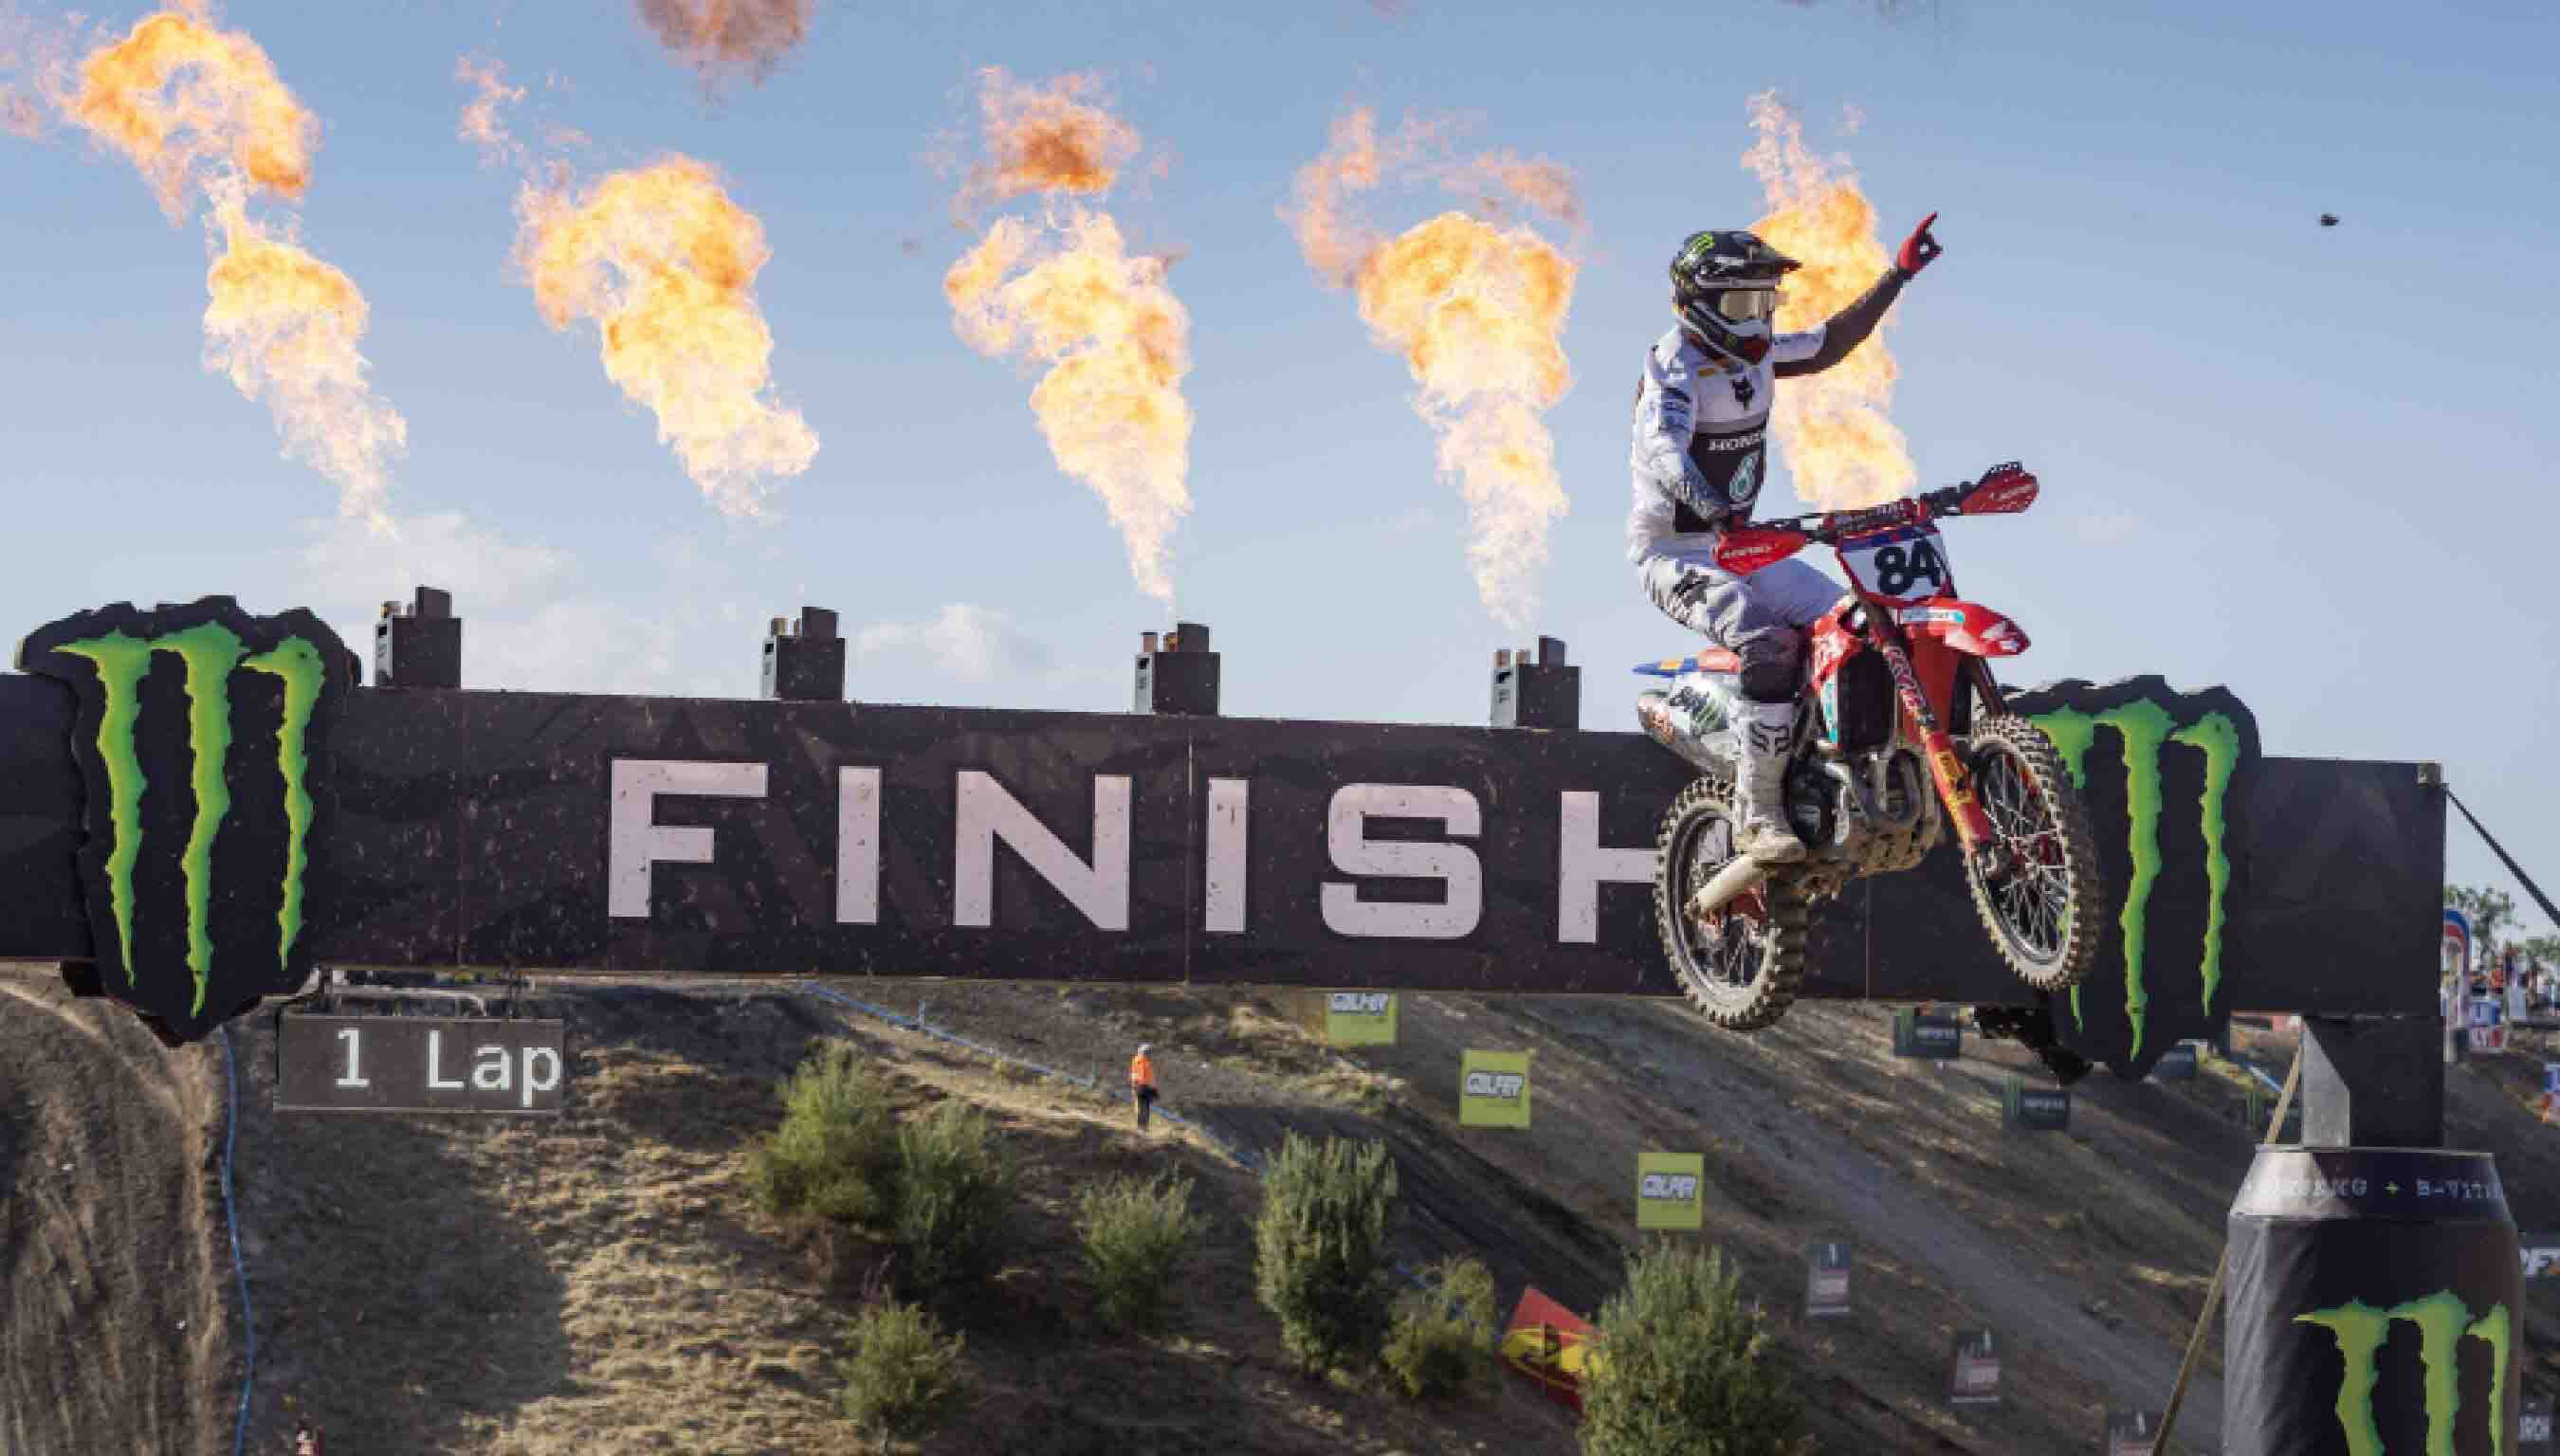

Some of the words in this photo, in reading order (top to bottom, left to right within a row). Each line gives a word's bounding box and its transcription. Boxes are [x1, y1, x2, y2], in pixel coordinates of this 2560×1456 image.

[1874, 537, 1942, 595] 84
[335, 1027, 371, 1086] 1
[427, 1028, 561, 1107] Lap
